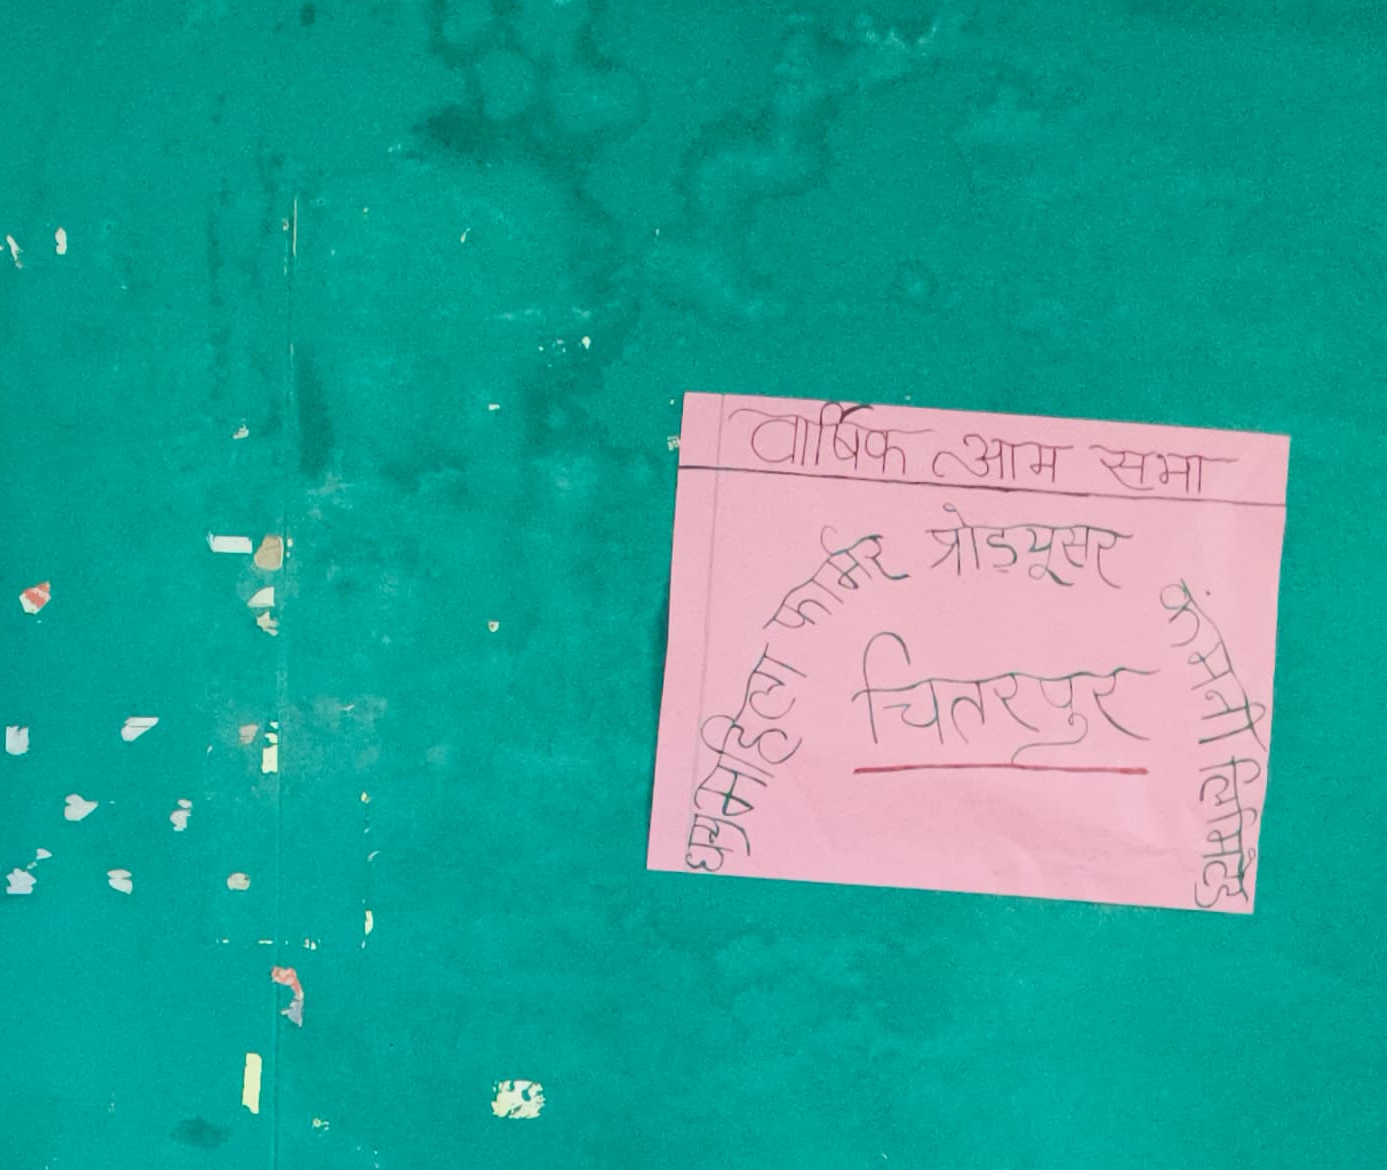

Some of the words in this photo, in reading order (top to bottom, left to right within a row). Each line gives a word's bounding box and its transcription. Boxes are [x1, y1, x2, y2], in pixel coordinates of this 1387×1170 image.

[728, 402, 933, 476] वार्षिक
[932, 434, 1074, 482] आम
[1089, 444, 1239, 493] सभा
[851, 631, 1162, 766] चितरपुर
[693, 641, 808, 815] महिला
[1194, 755, 1262, 909] लिमिटेड
